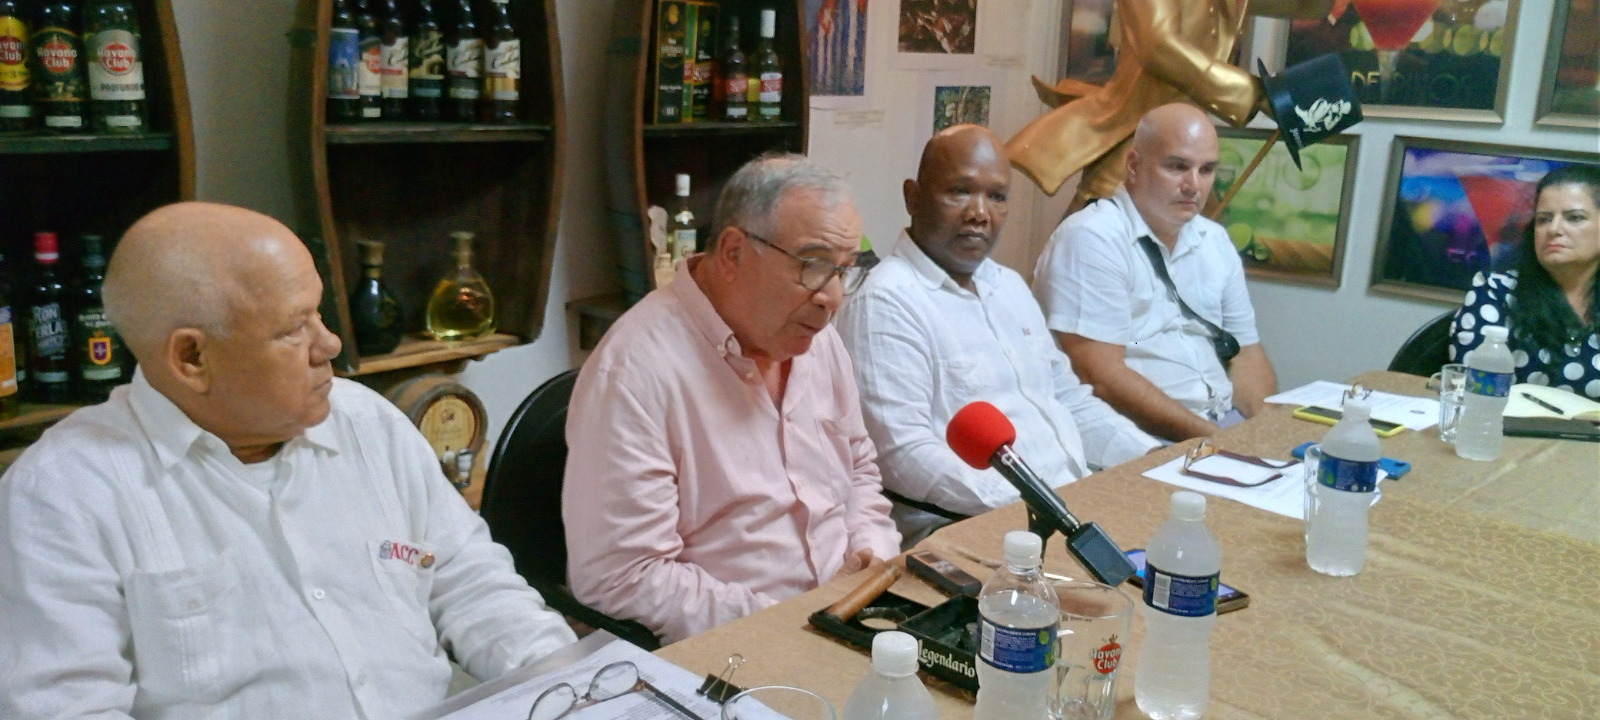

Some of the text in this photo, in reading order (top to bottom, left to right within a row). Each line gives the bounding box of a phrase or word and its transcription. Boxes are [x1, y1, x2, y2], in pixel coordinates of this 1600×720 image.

[46, 58, 70, 68] Club
[107, 59, 129, 68] Club
[389, 542, 419, 565] ACC
[917, 639, 976, 678] Legendario
[1097, 658, 1119, 671] Club
